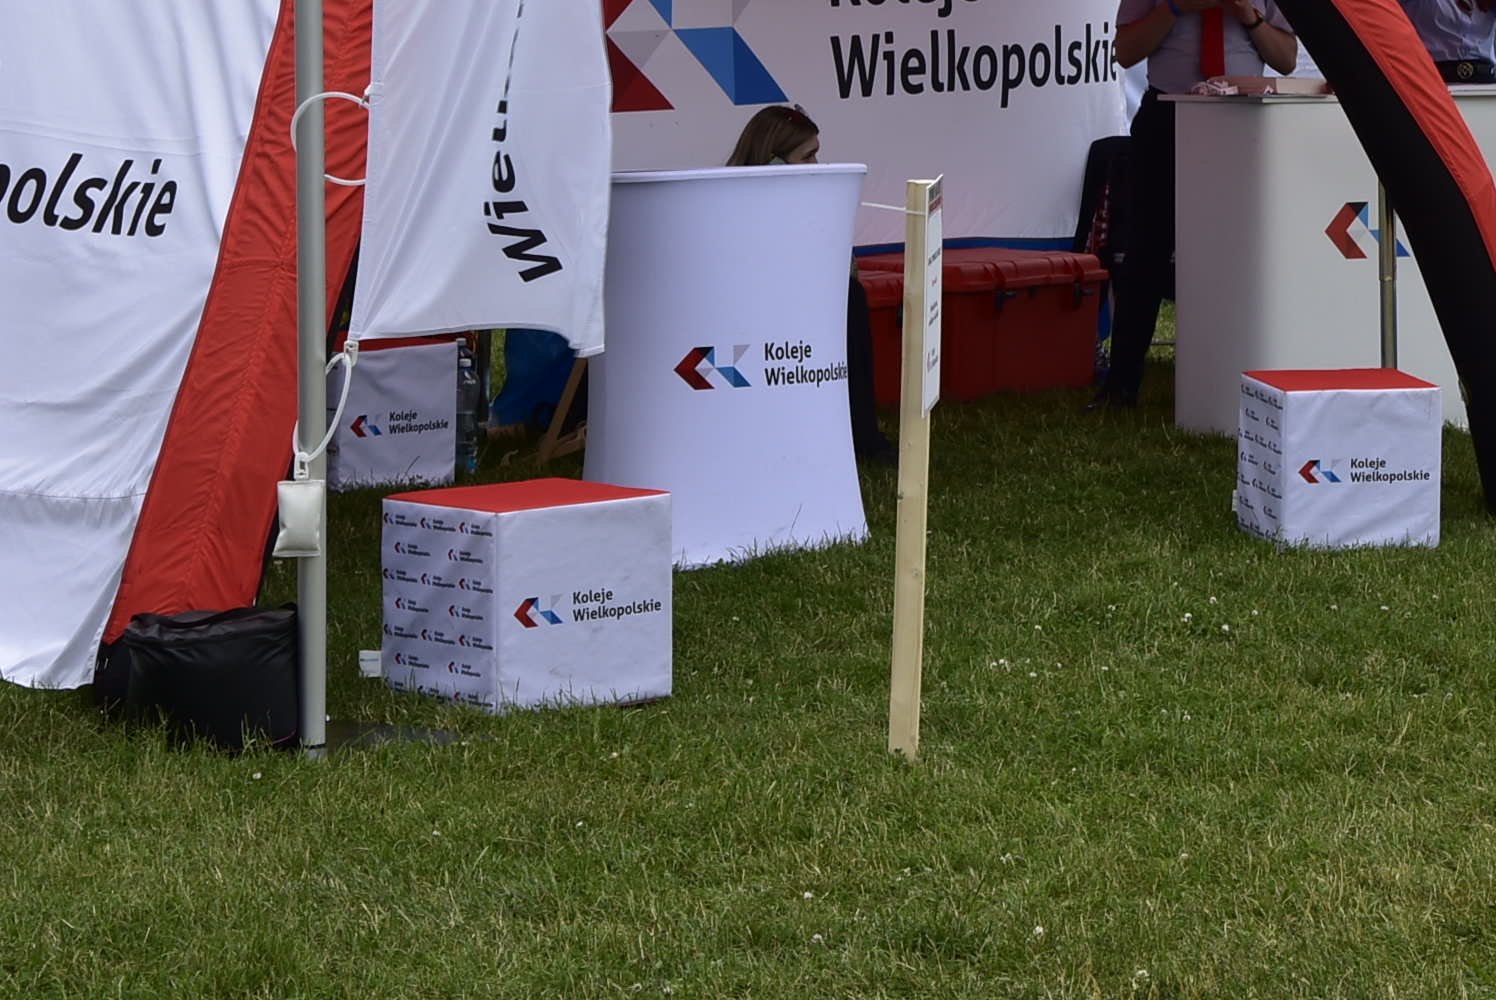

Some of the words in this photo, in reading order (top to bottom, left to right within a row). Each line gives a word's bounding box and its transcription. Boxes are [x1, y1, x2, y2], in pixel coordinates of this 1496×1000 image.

[829, 23, 1117, 108] Wielkopolskie
[765, 340, 812, 363] Koleje
[764, 361, 848, 388] Wielkopolskie
[389, 410, 418, 422] Koleje
[389, 419, 449, 434] Wielkopolskie
[1350, 457, 1386, 470] Koleje
[1350, 469, 1430, 484] Wielkopolskie
[573, 588, 613, 604] Koleje
[573, 599, 662, 621] Wielkopolskie
